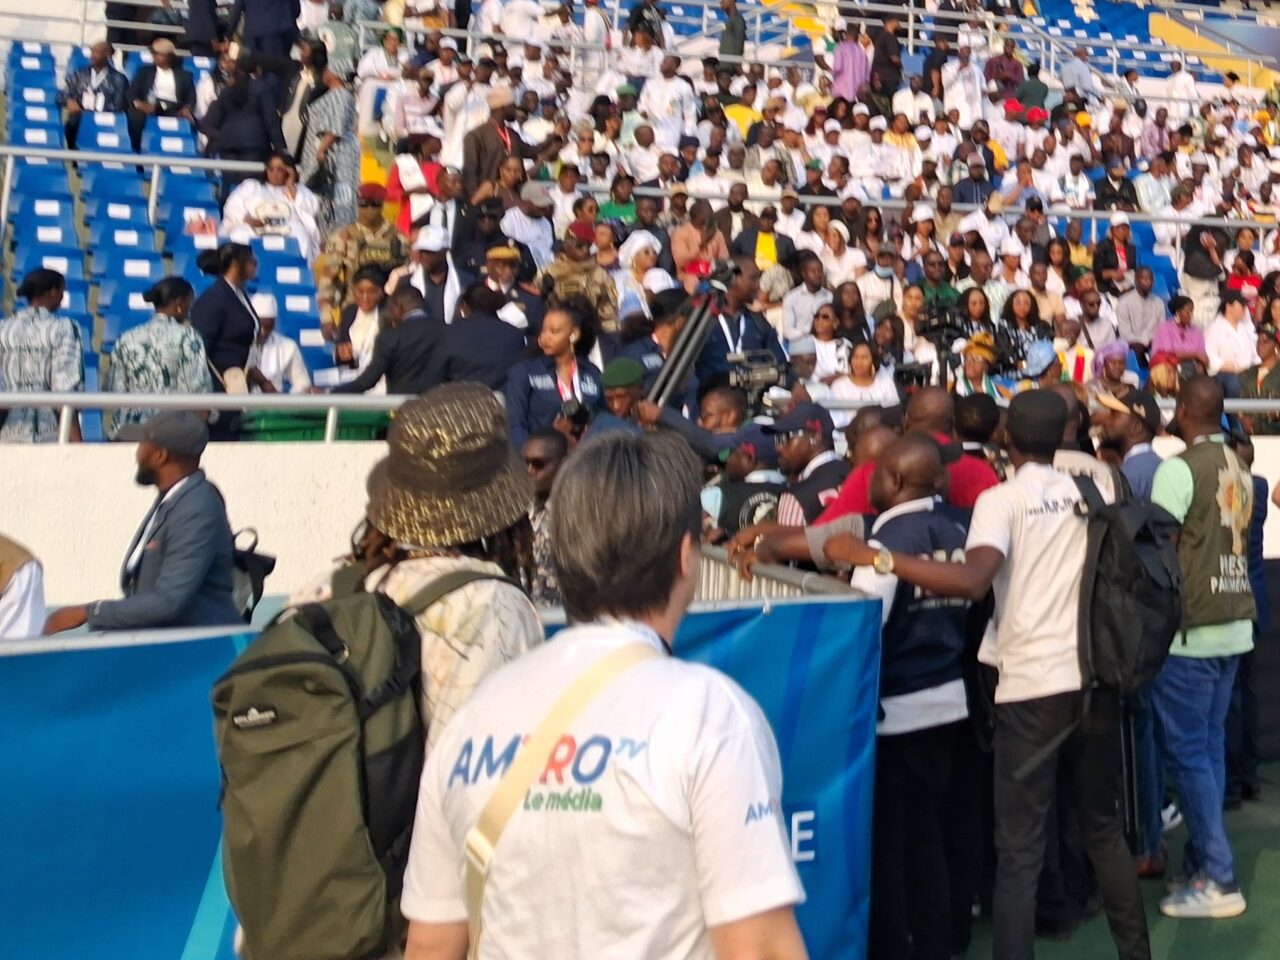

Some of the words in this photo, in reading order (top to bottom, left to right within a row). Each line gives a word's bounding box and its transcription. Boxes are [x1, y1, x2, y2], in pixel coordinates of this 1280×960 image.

[447, 734, 612, 789] AMRO
[614, 737, 648, 758] TV
[523, 788, 544, 811] Le
[545, 787, 604, 812] média
[791, 810, 816, 861] E
